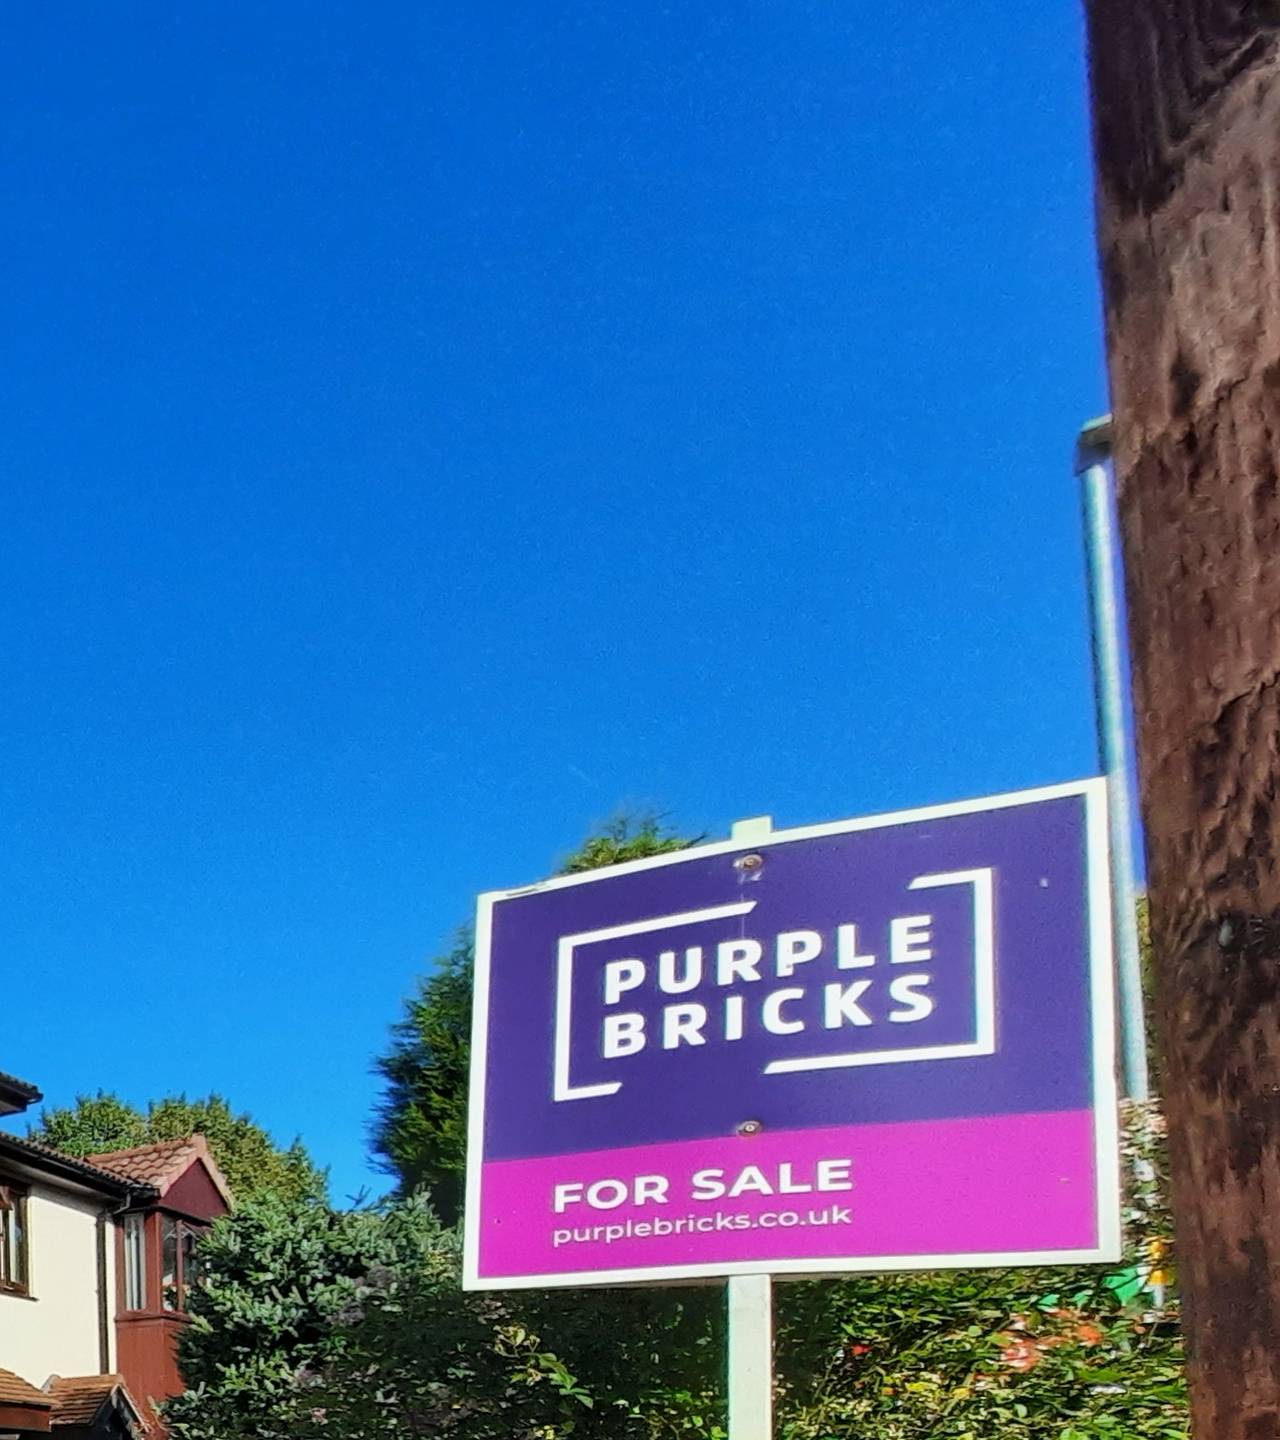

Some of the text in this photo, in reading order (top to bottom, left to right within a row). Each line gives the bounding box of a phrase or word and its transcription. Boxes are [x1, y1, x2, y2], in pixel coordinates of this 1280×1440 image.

[605, 915, 932, 1004] PURPLE
[604, 974, 933, 1058] BRICKS
[555, 1159, 852, 1212] FOR SALE
[554, 1205, 851, 1247] purplebricks.co.uk
